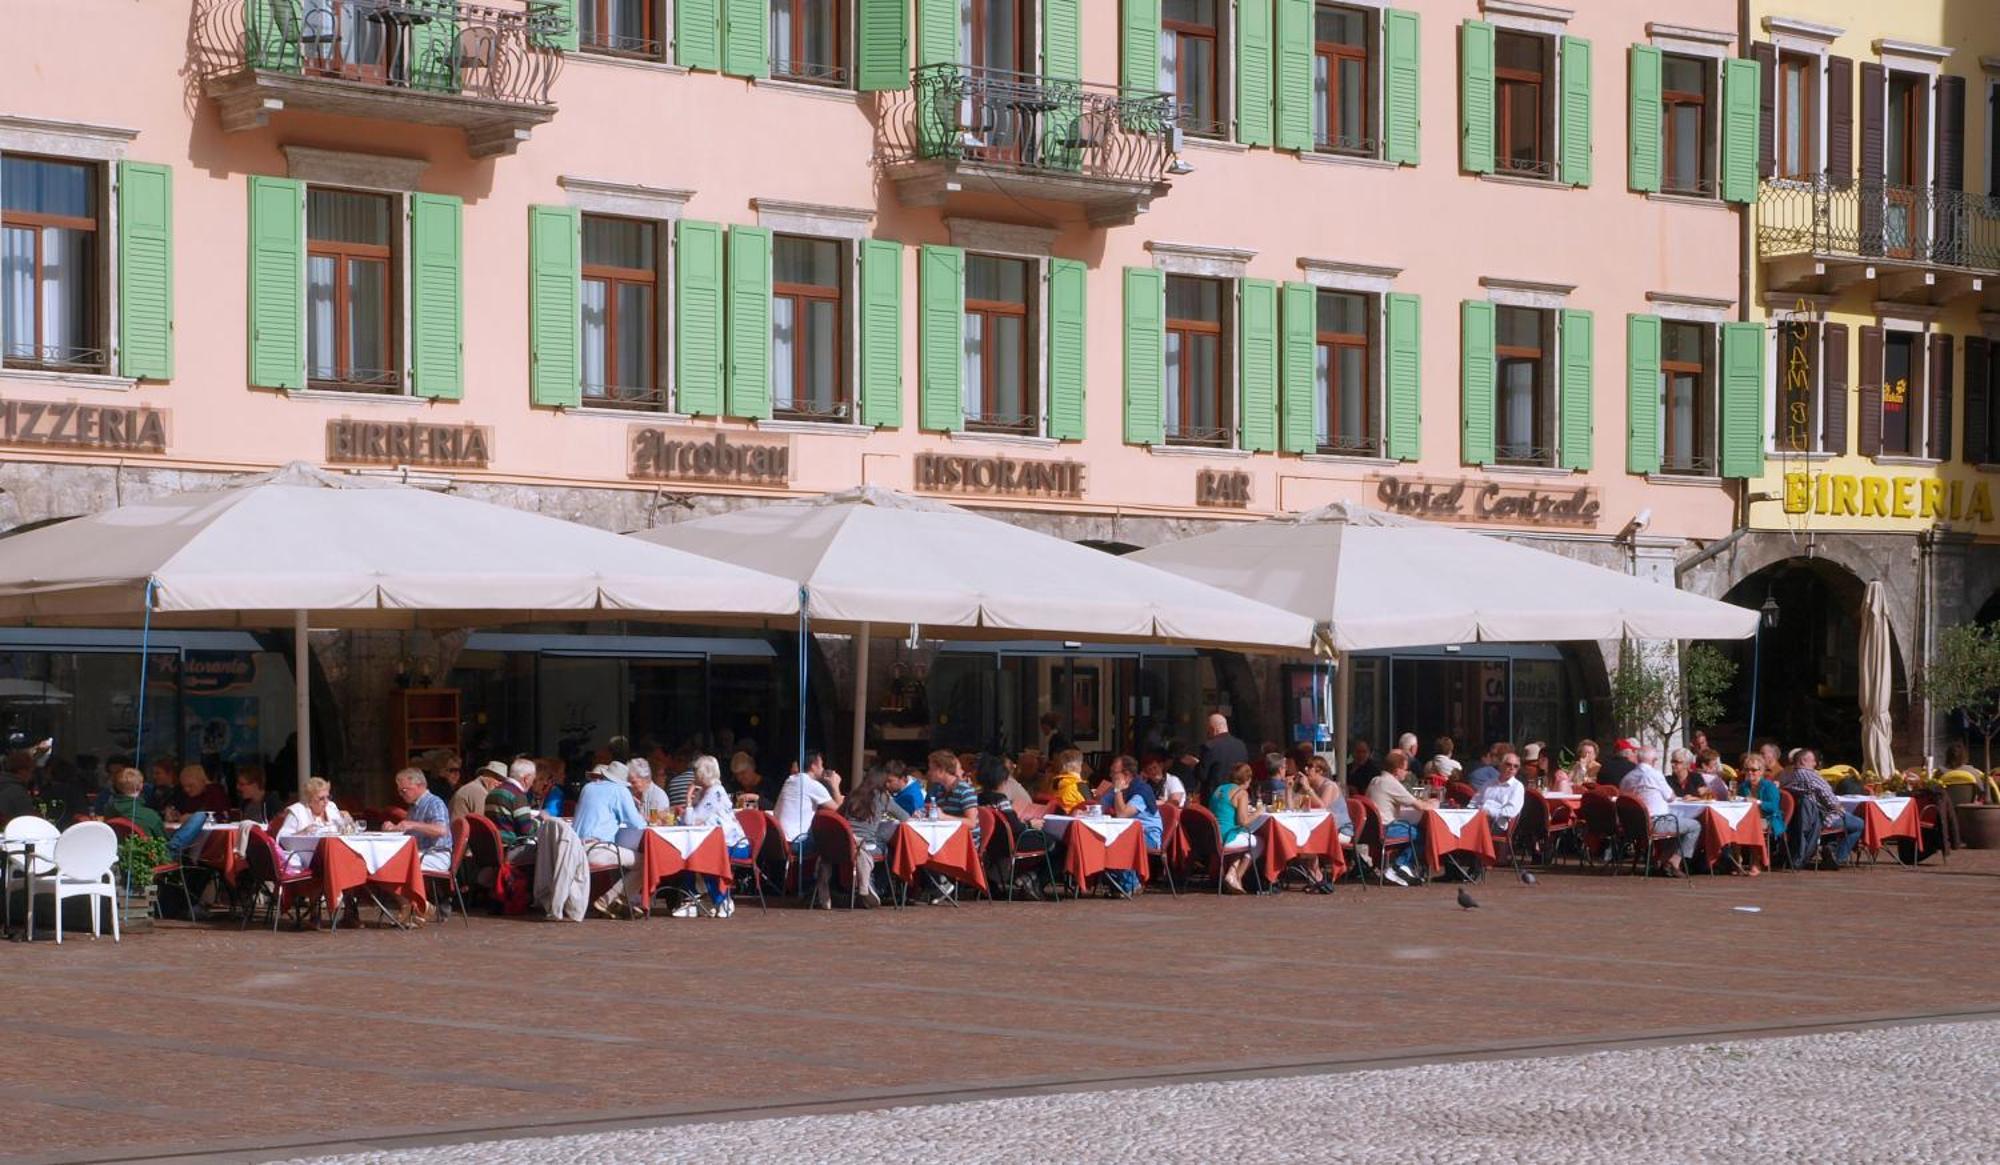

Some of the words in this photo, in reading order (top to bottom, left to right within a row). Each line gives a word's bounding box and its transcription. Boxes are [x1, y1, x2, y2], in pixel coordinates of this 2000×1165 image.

[334, 423, 488, 461] BIRRERIA
[917, 455, 1086, 494] RISTORANTE
[1198, 471, 1251, 502] BAR
[1378, 476, 1464, 515] Hotel
[1476, 483, 1600, 520] Centrale
[1785, 473, 1994, 521] BIRRERIA
[156, 654, 248, 675] Rstorante
[1487, 678, 1557, 698] CABUSA
